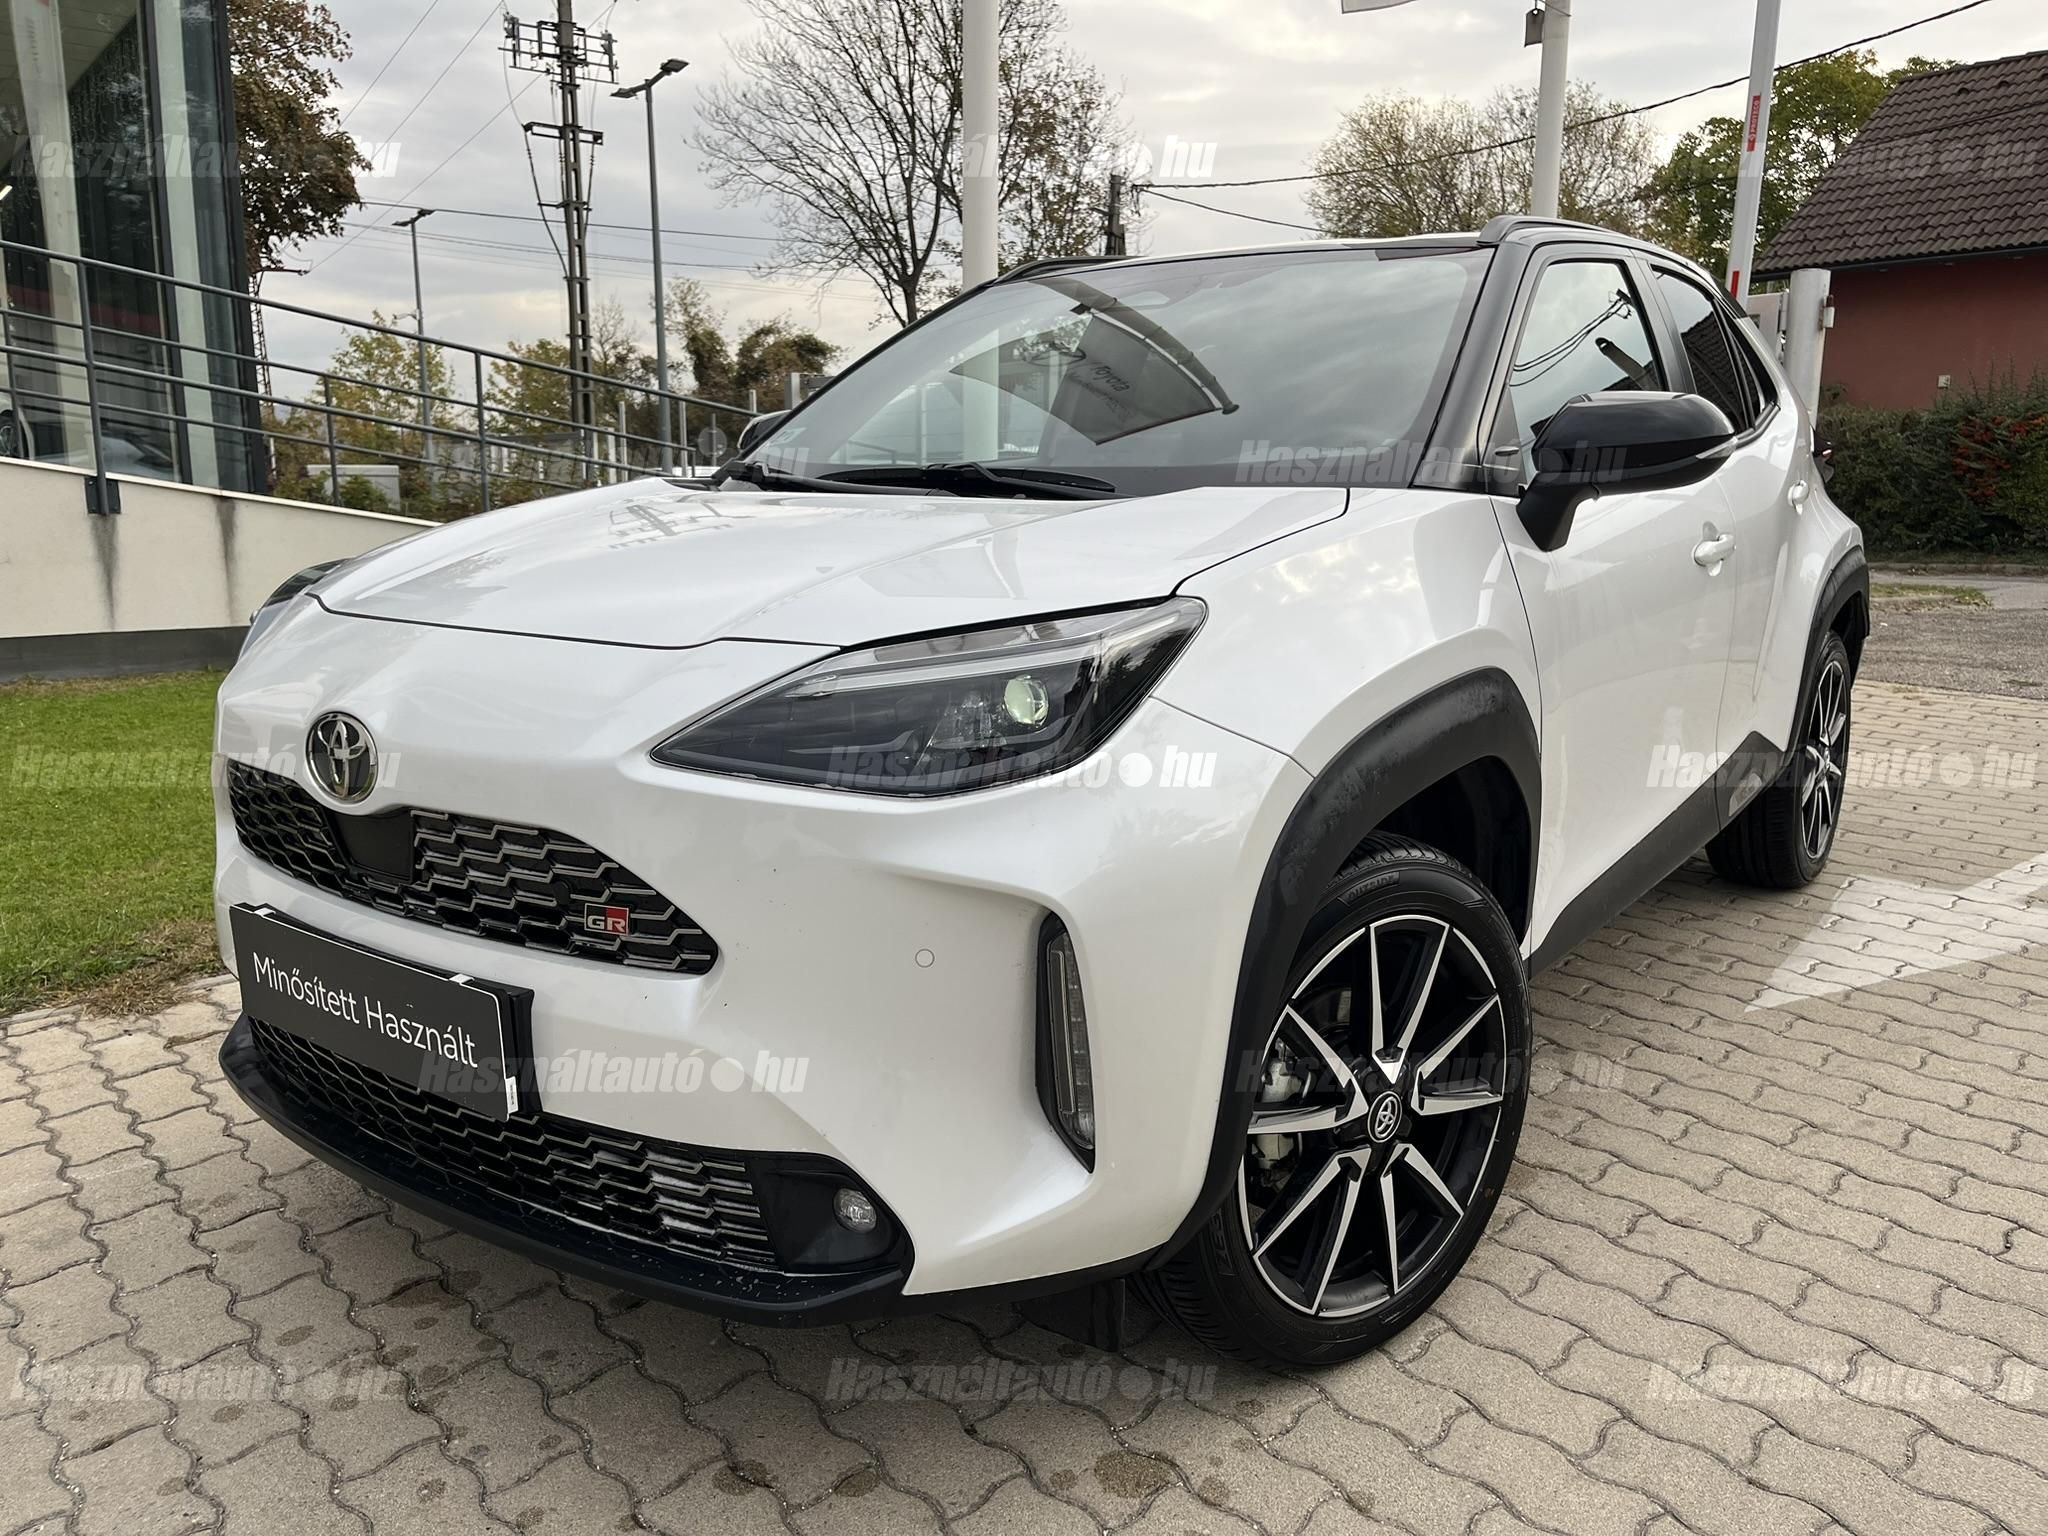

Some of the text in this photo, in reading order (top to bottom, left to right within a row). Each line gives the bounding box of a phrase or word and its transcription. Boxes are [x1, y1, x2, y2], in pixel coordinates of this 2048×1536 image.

[587, 915, 626, 932] GR
[253, 952, 478, 1068] Minősített Használt
